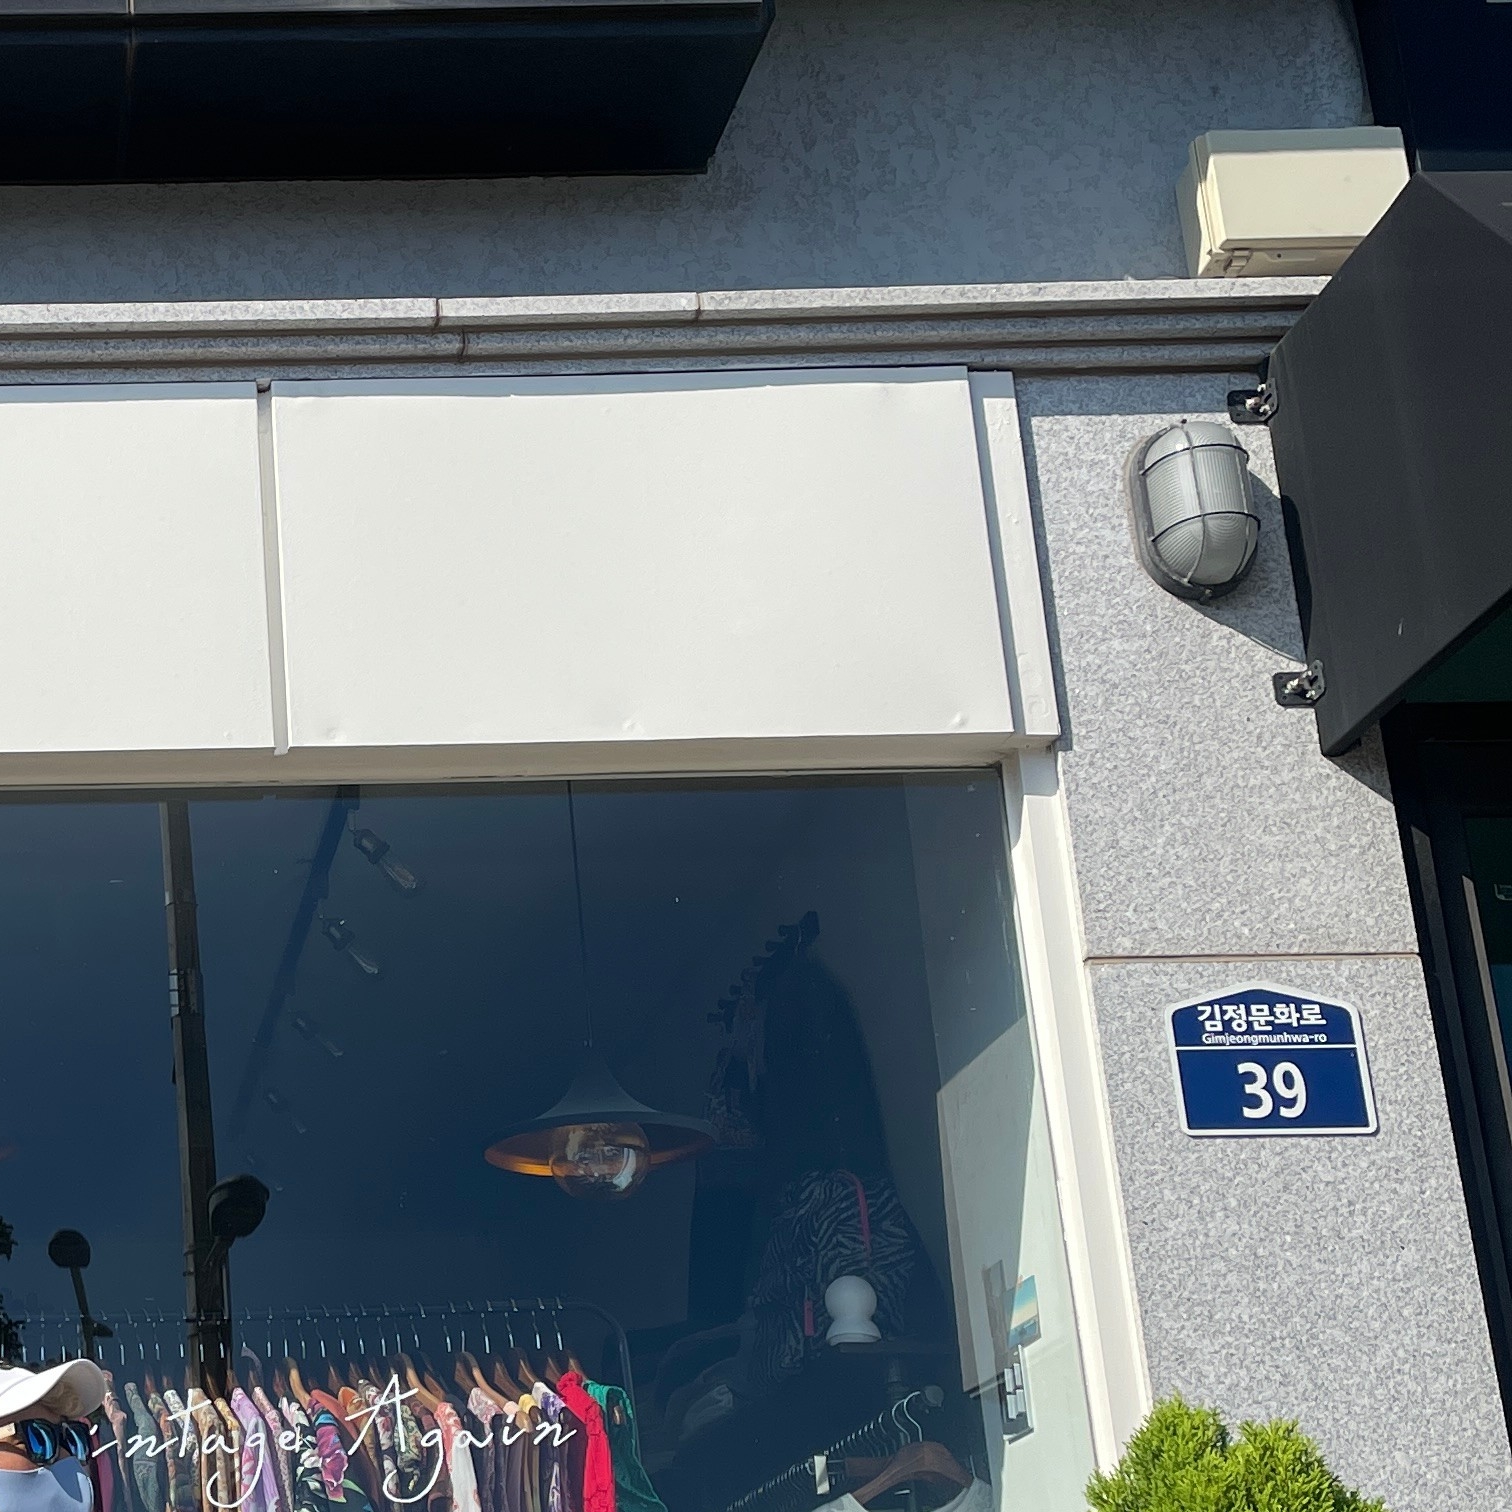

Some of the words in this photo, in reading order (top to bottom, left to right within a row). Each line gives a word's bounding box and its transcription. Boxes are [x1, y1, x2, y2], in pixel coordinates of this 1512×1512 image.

[1197, 1003, 1328, 1033] 김정문화로
[1201, 1031, 1328, 1046] Gimjeongmunhwa-ro
[1237, 1061, 1307, 1119] 39
[344, 1373, 578, 1504] Again
